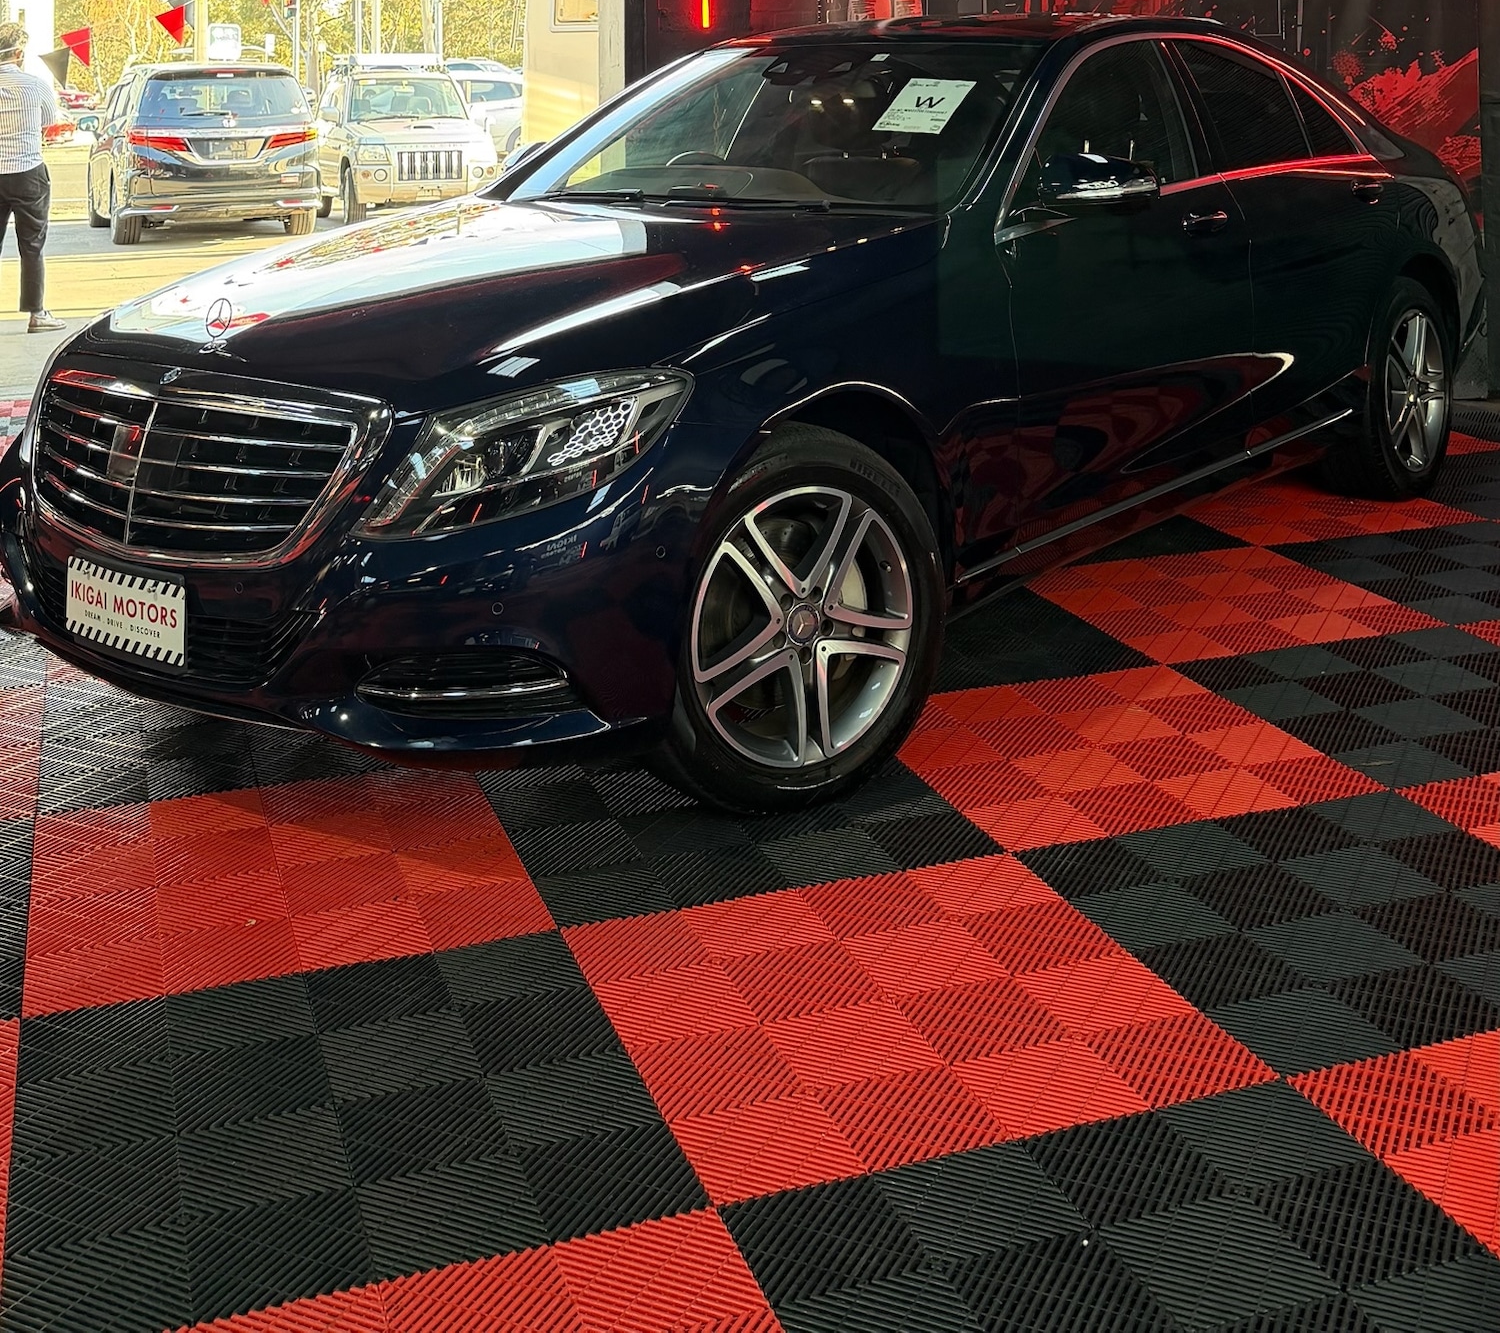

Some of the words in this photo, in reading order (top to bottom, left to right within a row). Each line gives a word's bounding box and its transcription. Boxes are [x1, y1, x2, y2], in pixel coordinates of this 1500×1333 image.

[915, 96, 946, 109] W
[71, 580, 107, 610] IKIGAI
[113, 595, 177, 628] MOTORS
[84, 609, 101, 622] DREAM
[107, 617, 123, 629] DRIVE
[130, 624, 161, 639] DISCOVER
